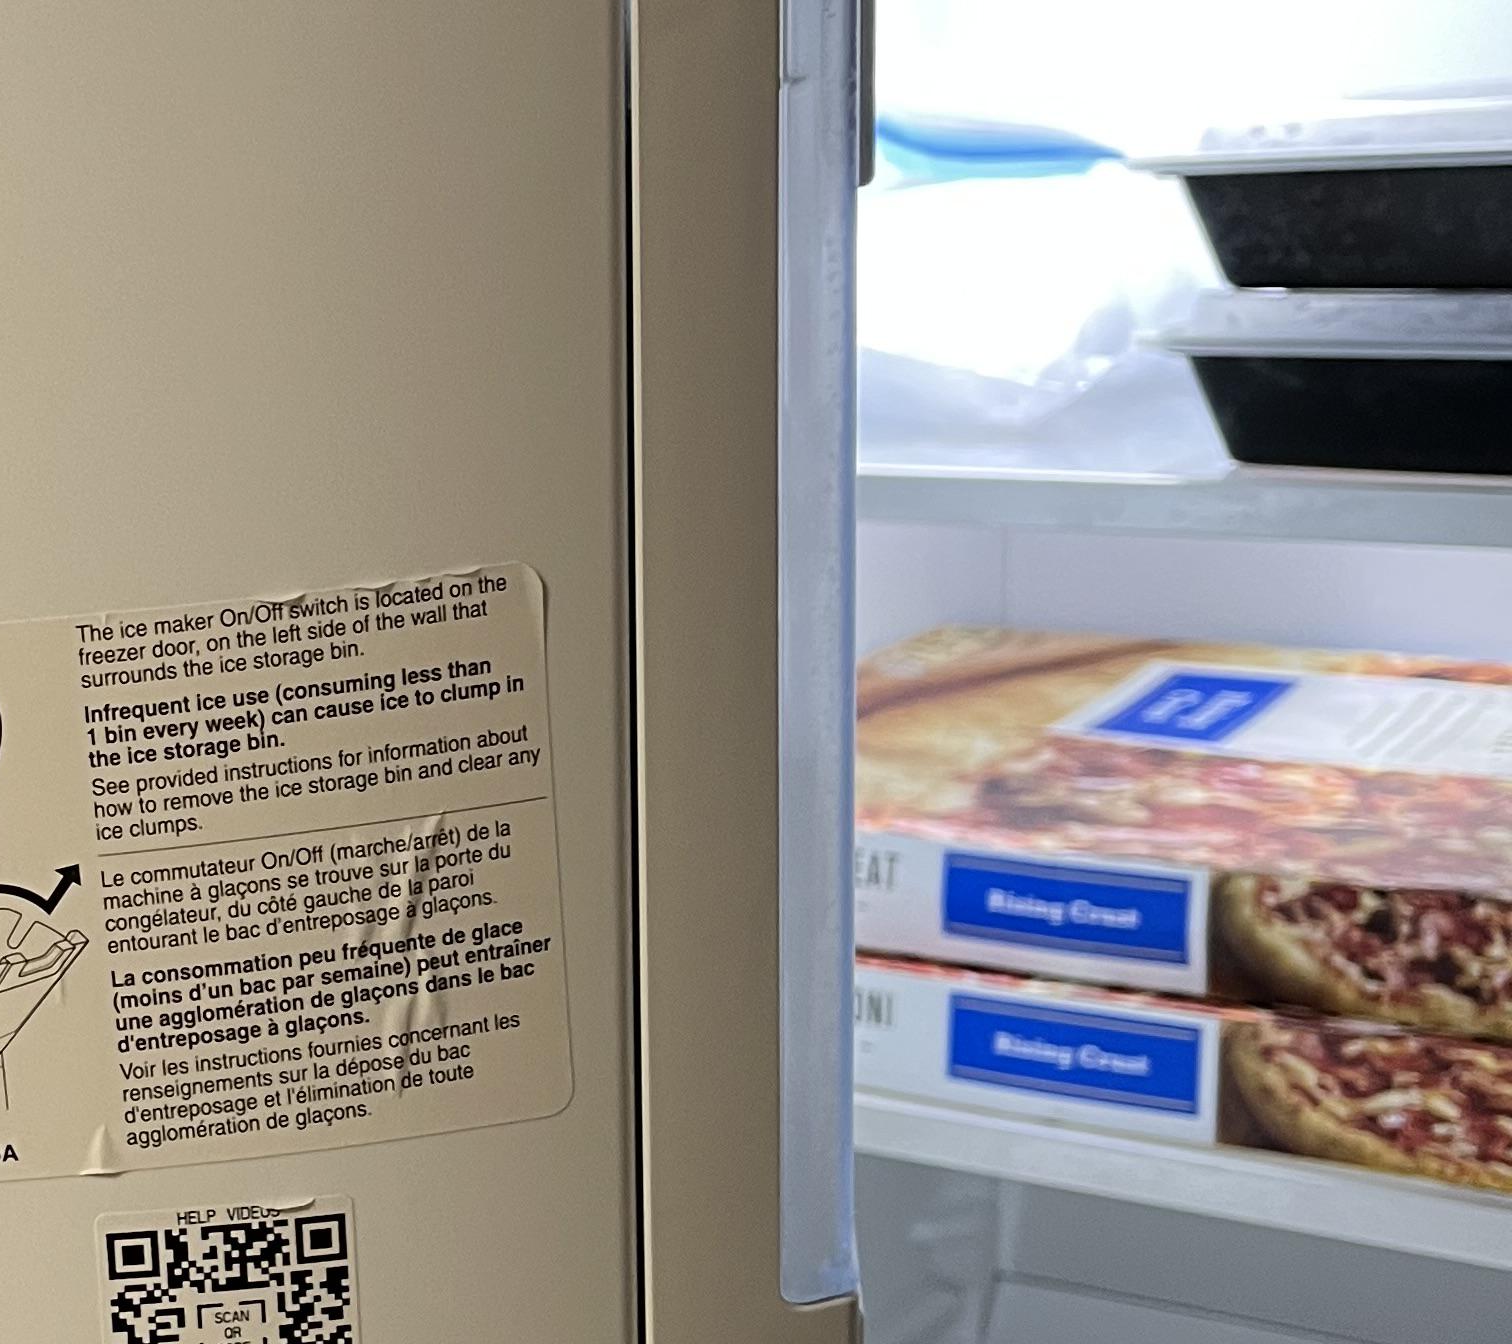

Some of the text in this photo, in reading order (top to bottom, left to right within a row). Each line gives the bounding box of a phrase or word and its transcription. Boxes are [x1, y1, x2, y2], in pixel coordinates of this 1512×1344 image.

[76, 575, 507, 643] The ice maker On/Off switch is located on the
[78, 599, 488, 666] freezer door, on the left side of the wall that
[81, 640, 364, 688] surrounds the ice storage bin.
[84, 660, 491, 723] Infrequent ice use (consuming less than
[87, 675, 524, 746] 1 bin every week) can cause ice to clump in
[88, 730, 285, 768] the ice storage bin.
[92, 724, 528, 797] See provided instructions for information about
[94, 748, 540, 819] how to remove the ice storage bin and clear any
[96, 817, 203, 840] ice clumps.
[100, 821, 511, 888] Le commutateur On/Off (marche/arrêt) de la
[103, 843, 511, 910] machine à glaçons se trouve sur la porte du
[105, 872, 474, 933] congélateur, du côté gauche de la paroi
[107, 928, 198, 954] entourant
[203, 926, 220, 943] le
[225, 923, 261, 941] bac
[406, 898, 417, 919] à
[421, 891, 497, 919] glaçons.
[111, 921, 523, 988] La consommation peu fréquente de glace
[113, 989, 183, 1014] (moins
[239, 978, 276, 995] bac
[282, 973, 315, 995] par
[320, 956, 411, 985] semaine)
[416, 949, 460, 976] peut
[464, 937, 551, 964] entraîner
[115, 962, 535, 1031] une agglomération de glaçons dans le bac
[267, 1018, 279, 1036] à
[285, 1011, 370, 1038] glaçons.
[121, 1013, 520, 1080] Voir les instructions fournies concernant les
[122, 1044, 471, 1102] renseignements sur la dépose du bac
[264, 1090, 282, 1108] et
[400, 1069, 423, 1090] de
[428, 1064, 474, 1084] toute
[126, 1103, 372, 1149] agglomération de glaçons.
[176, 1205, 280, 1225] HELP VIDEOS
[215, 1310, 249, 1324] SCAN
[224, 1326, 241, 1339] QR
